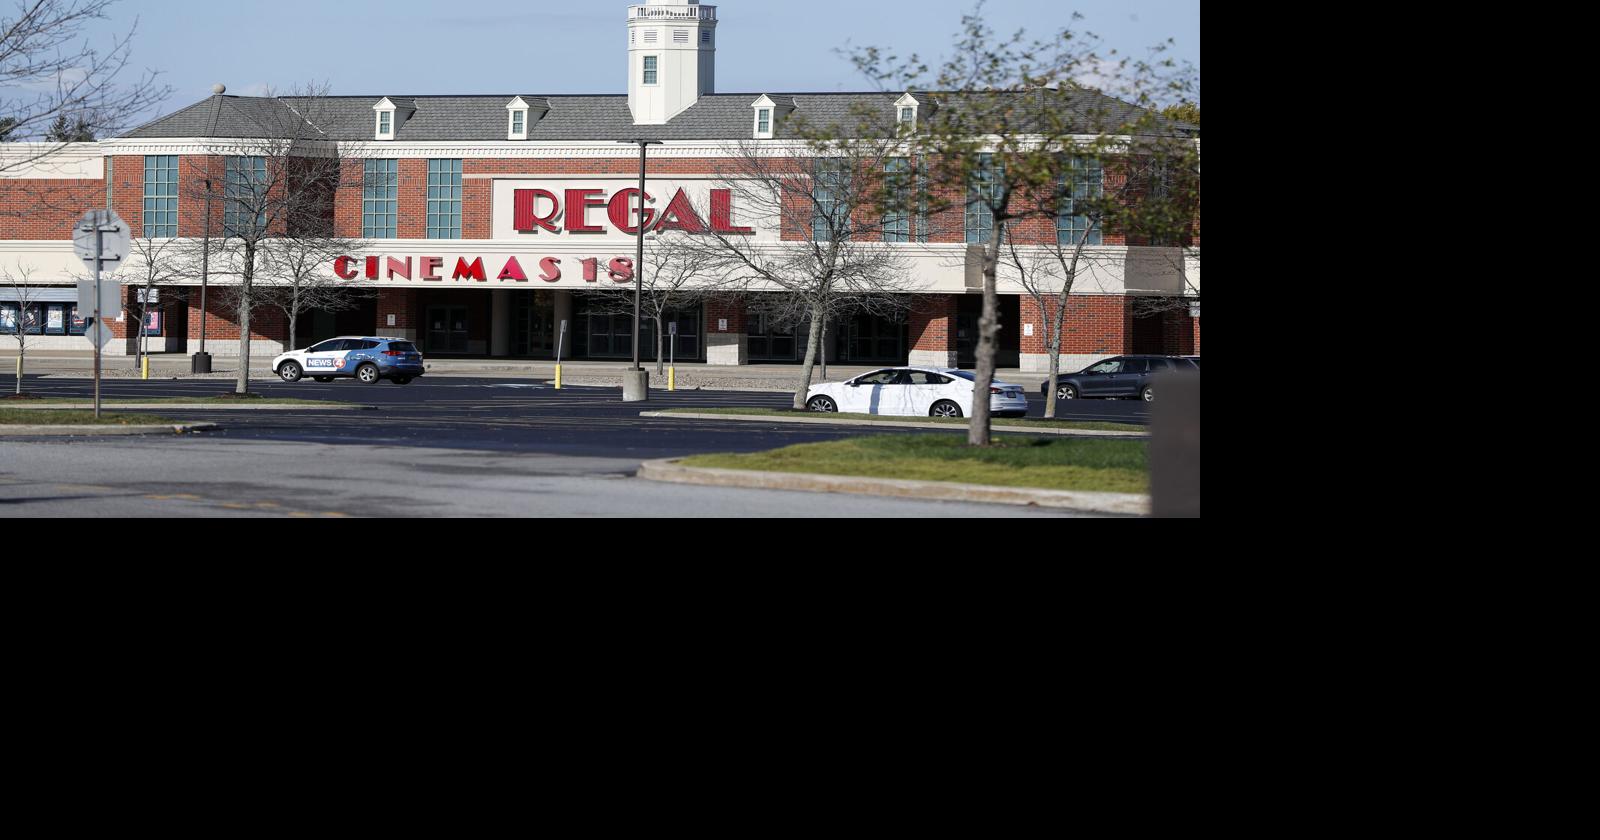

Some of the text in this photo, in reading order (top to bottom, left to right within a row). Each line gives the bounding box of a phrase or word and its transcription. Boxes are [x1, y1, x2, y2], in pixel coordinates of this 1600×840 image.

[513, 186, 754, 236] REGAL
[334, 254, 635, 283] CINEMAS 18
[308, 359, 344, 367] NEWS 4
